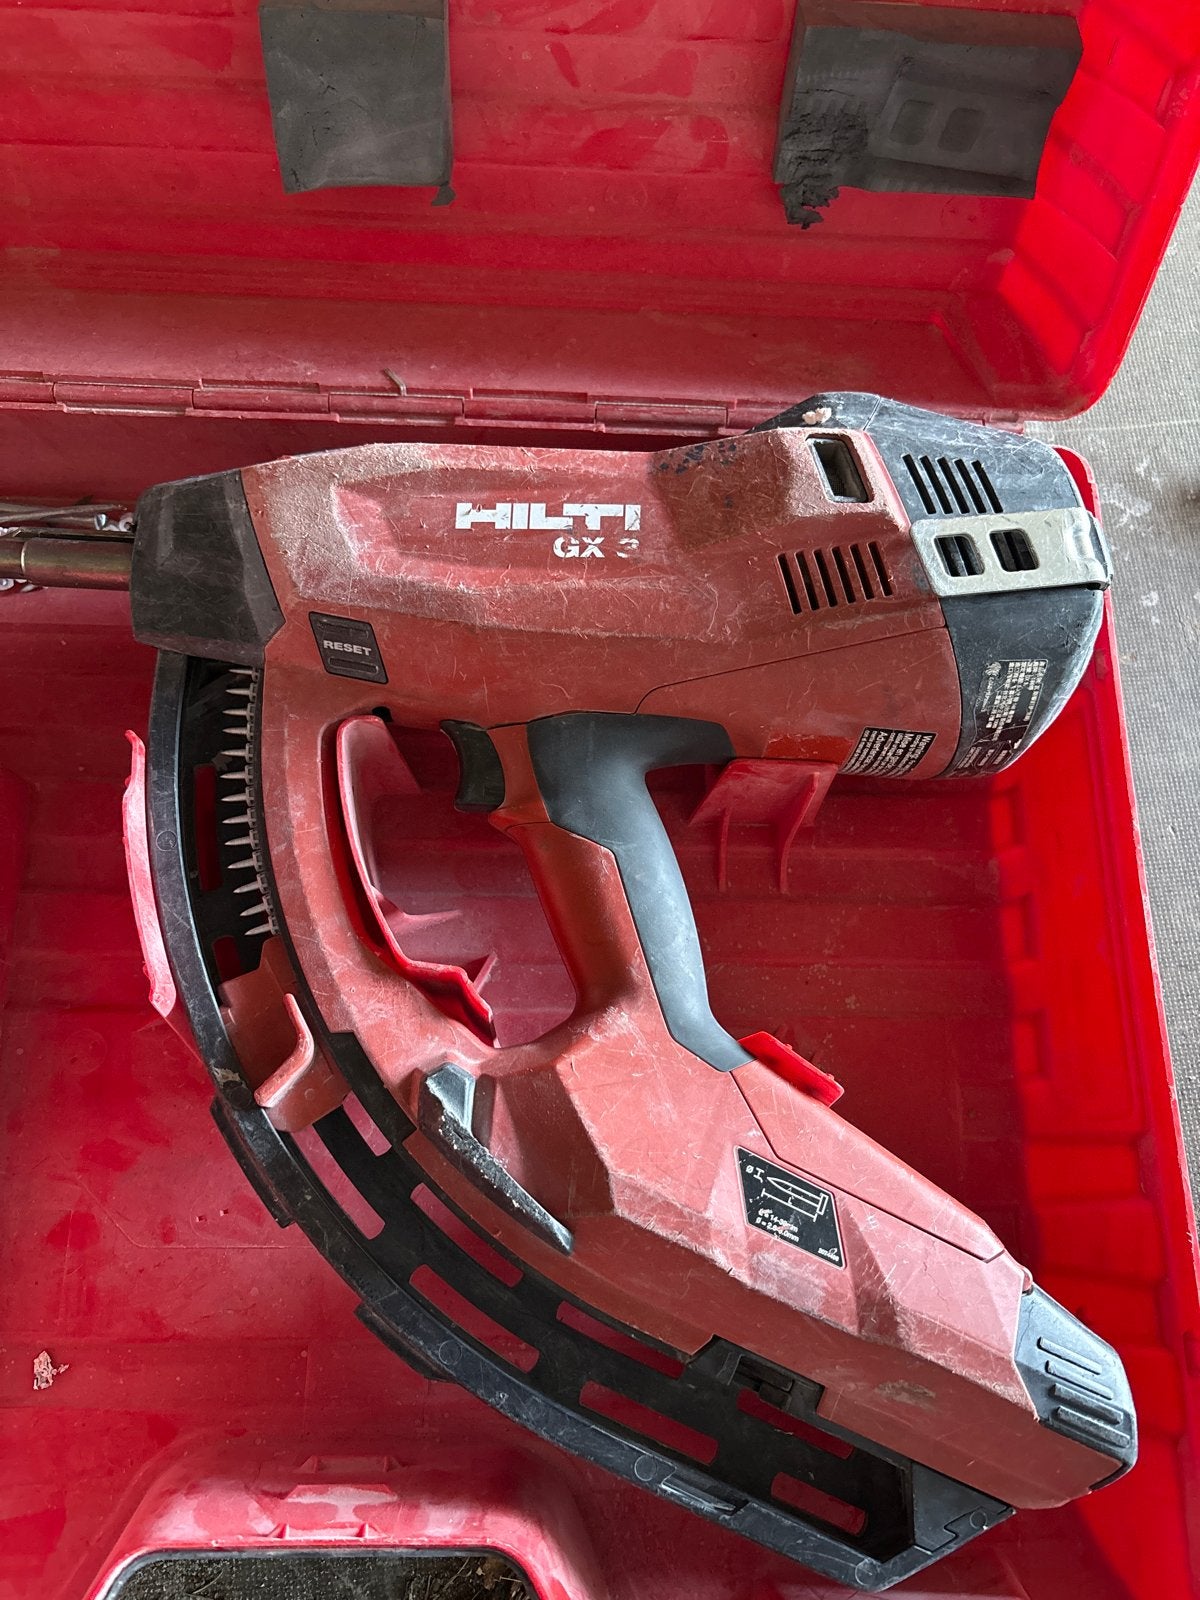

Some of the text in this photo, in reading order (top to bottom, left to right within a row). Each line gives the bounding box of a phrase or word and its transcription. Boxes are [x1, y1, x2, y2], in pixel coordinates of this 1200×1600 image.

[455, 502, 641, 531] HILTI
[553, 536, 605, 558] GX
[323, 640, 372, 656] RESET
